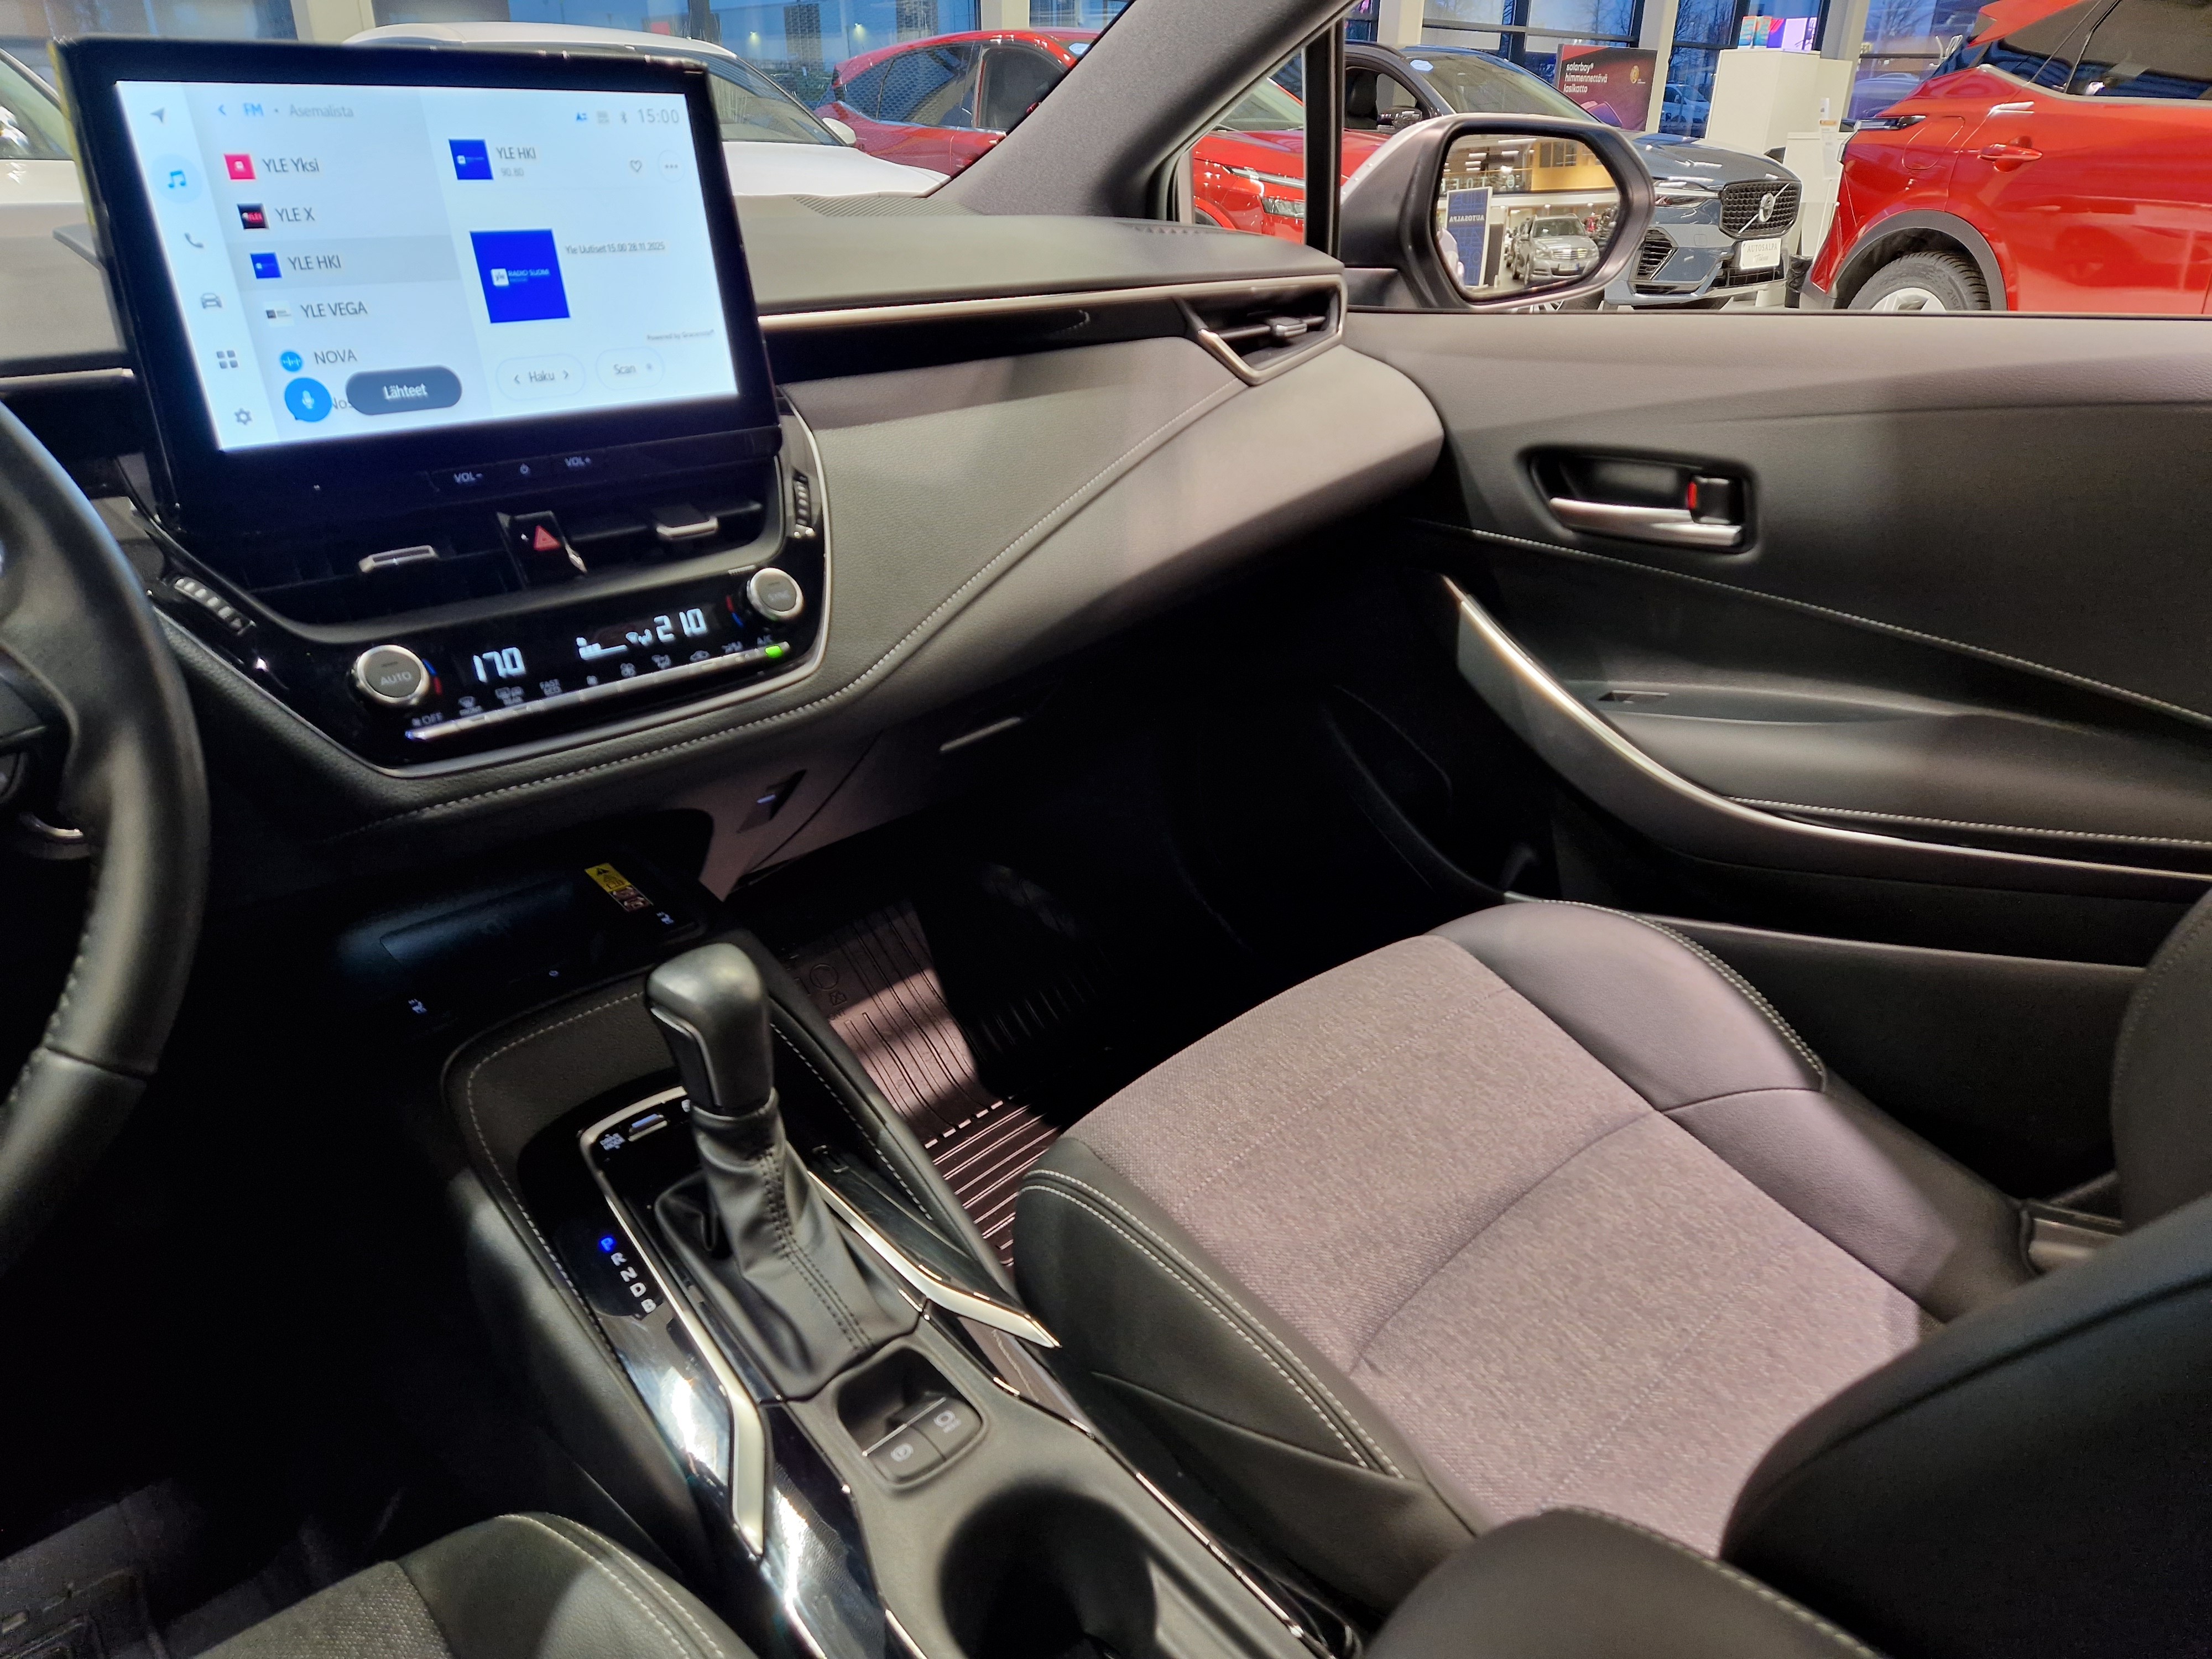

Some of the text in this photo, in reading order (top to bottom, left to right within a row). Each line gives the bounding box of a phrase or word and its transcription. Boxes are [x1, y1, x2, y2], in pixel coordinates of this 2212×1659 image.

[1564, 72, 1608, 84] himmennettävä
[1563, 84, 1588, 93] lasikatto
[243, 103, 354, 118] FM Asemalista
[638, 108, 680, 123] 15:00
[496, 147, 536, 159] YLE HKI
[262, 156, 320, 173] YLE Yksi
[275, 207, 316, 222] YLE X
[1747, 242, 1777, 253] AUTOSALPA
[287, 254, 341, 271] YLE HKI
[300, 300, 368, 319] YLE VEGA
[314, 348, 358, 365] NOVA
[529, 370, 555, 383] Haku
[613, 363, 637, 375] Scan
[383, 383, 428, 400] Lähteet
[380, 671, 413, 686] AUTO
[601, 1237, 656, 1313] P R N D B
